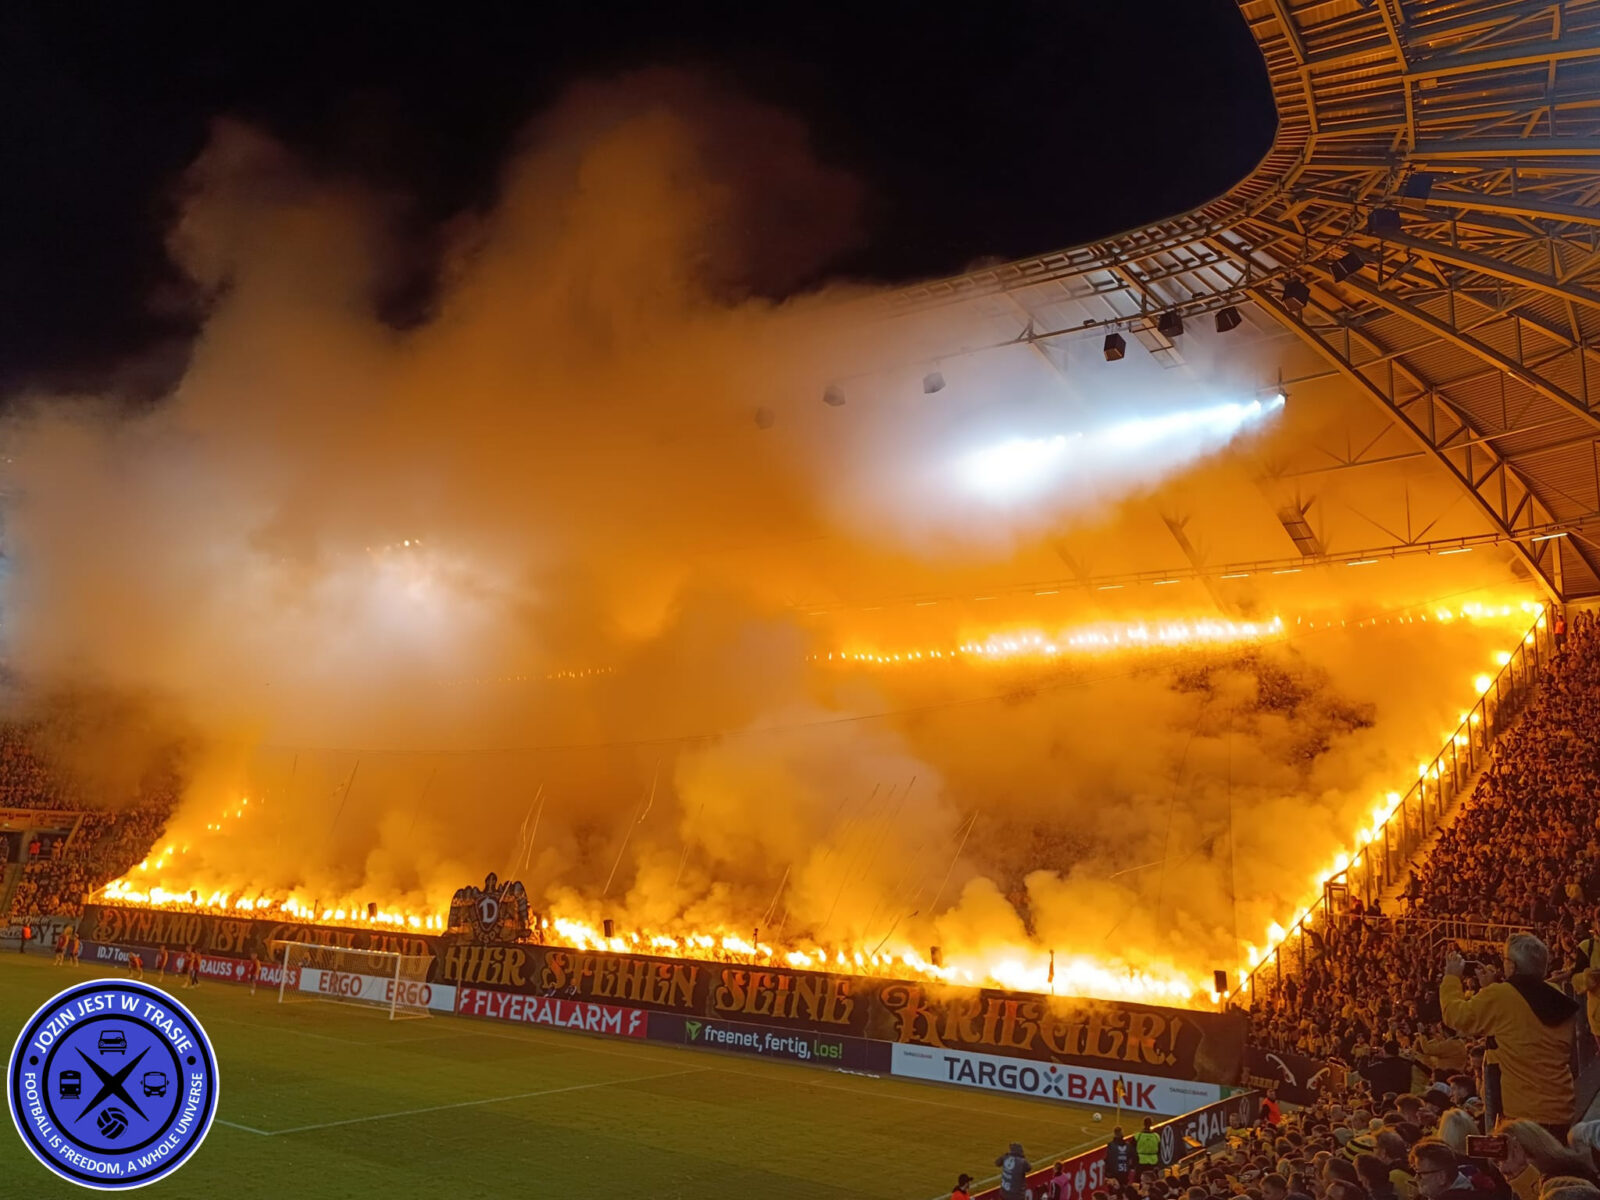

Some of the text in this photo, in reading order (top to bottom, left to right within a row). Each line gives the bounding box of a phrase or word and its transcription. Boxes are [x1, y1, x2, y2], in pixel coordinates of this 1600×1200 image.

[93, 908, 200, 945] DYNAMO
[209, 919, 253, 953] IST
[444, 946, 526, 986] HIER
[542, 951, 699, 1008] STEHEN
[714, 968, 854, 1025] SEINE
[881, 985, 1183, 1066] KRIEGER!
[319, 971, 363, 997] ERGO
[385, 980, 432, 1006] ERGO
[473, 991, 623, 1034] FLYERALARM
[704, 1025, 843, 1059] freenet, fertig, los!
